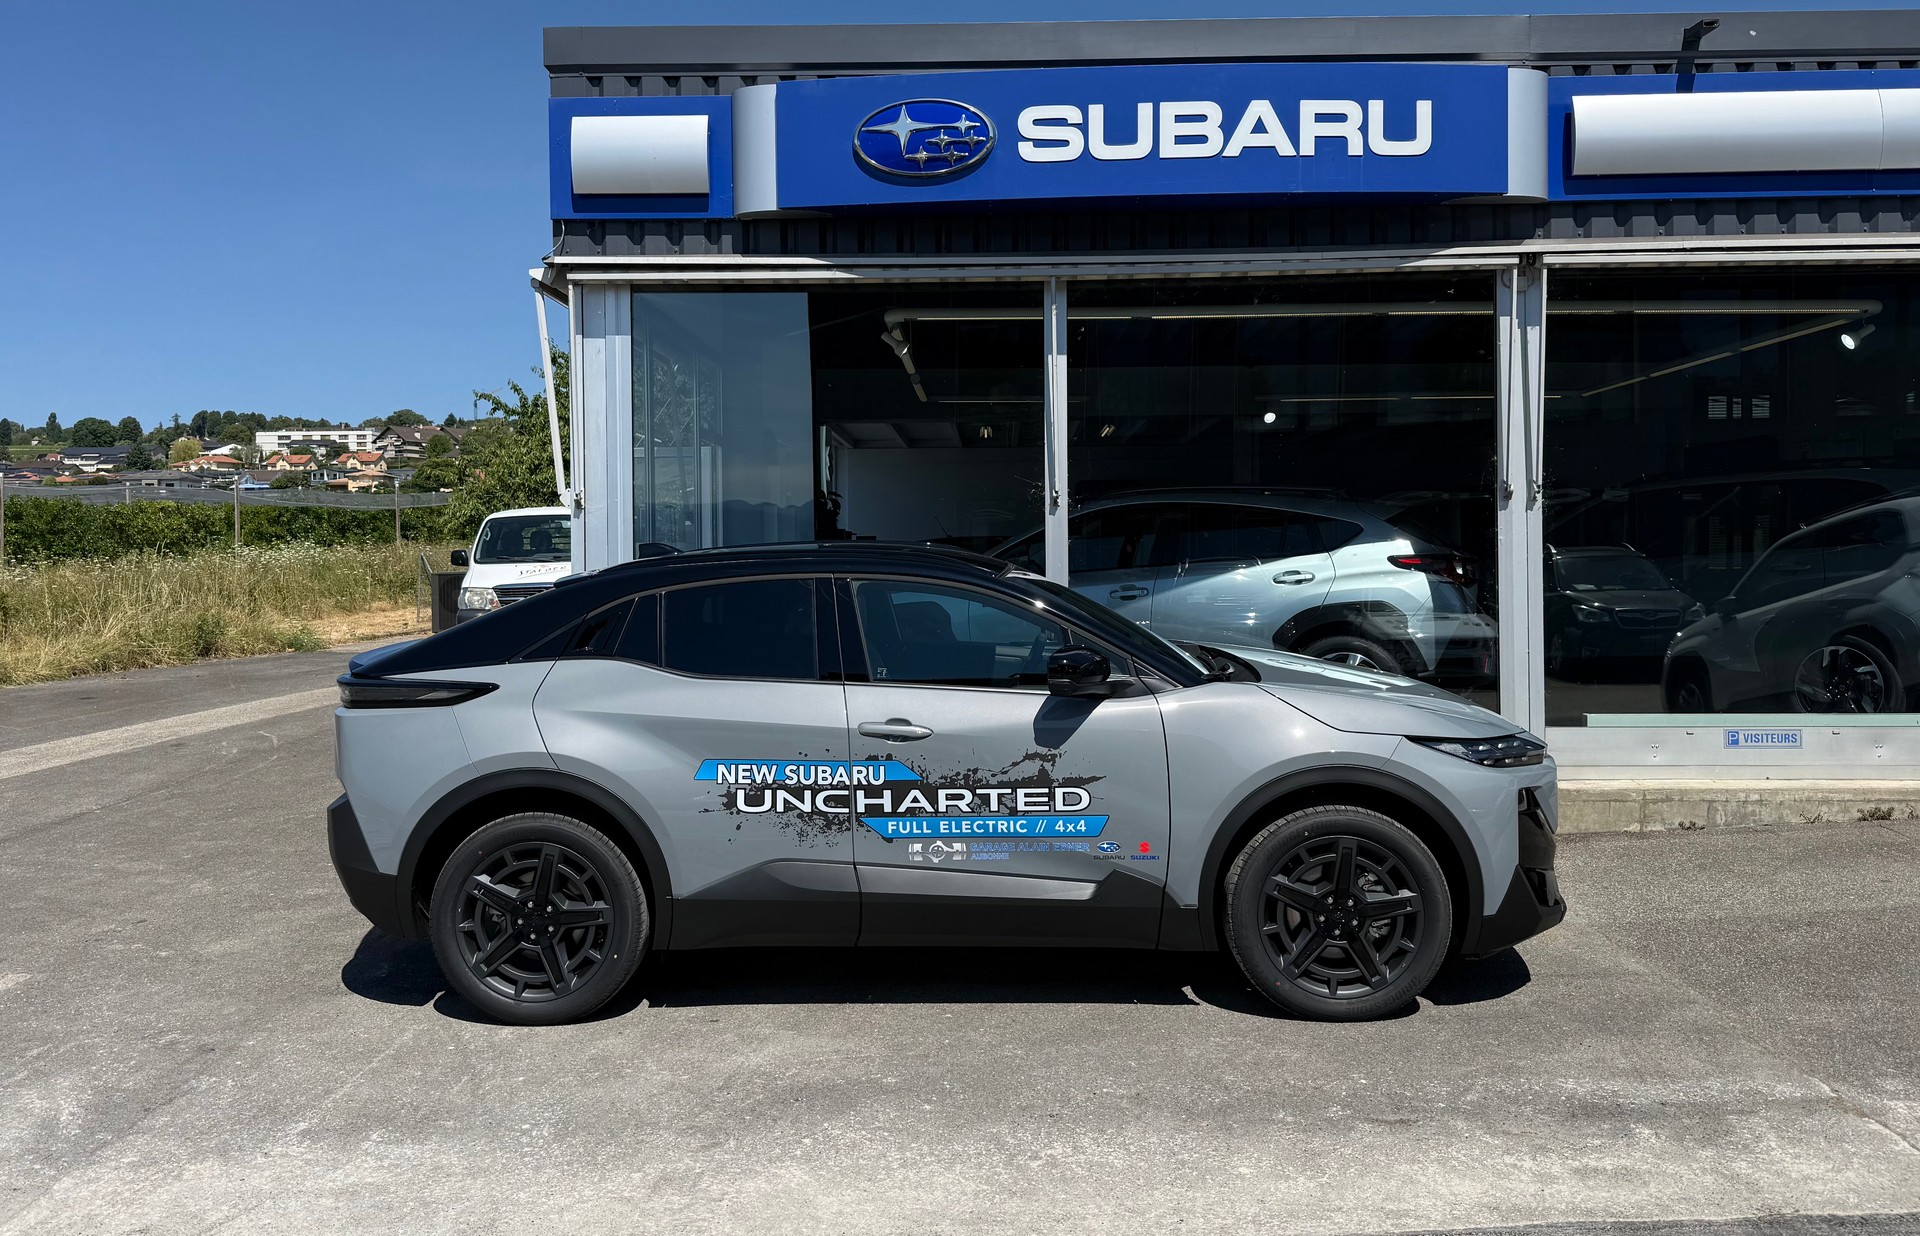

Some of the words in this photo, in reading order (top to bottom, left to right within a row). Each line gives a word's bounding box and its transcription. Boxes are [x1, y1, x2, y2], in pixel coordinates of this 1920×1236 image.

[1016, 100, 1432, 162] SUBARU
[1728, 732, 1738, 744] P
[1743, 733, 1798, 743] VISITEURS
[717, 764, 777, 784] NEW
[784, 765, 885, 785] SUBARU
[736, 787, 1091, 813] UNCHARTED
[887, 820, 932, 834] FULL
[939, 820, 1028, 833] ELECTRIC
[1055, 819, 1087, 832] 4x4
[970, 842, 1015, 851] GARAGE
[1018, 843, 1050, 851] ALAIN
